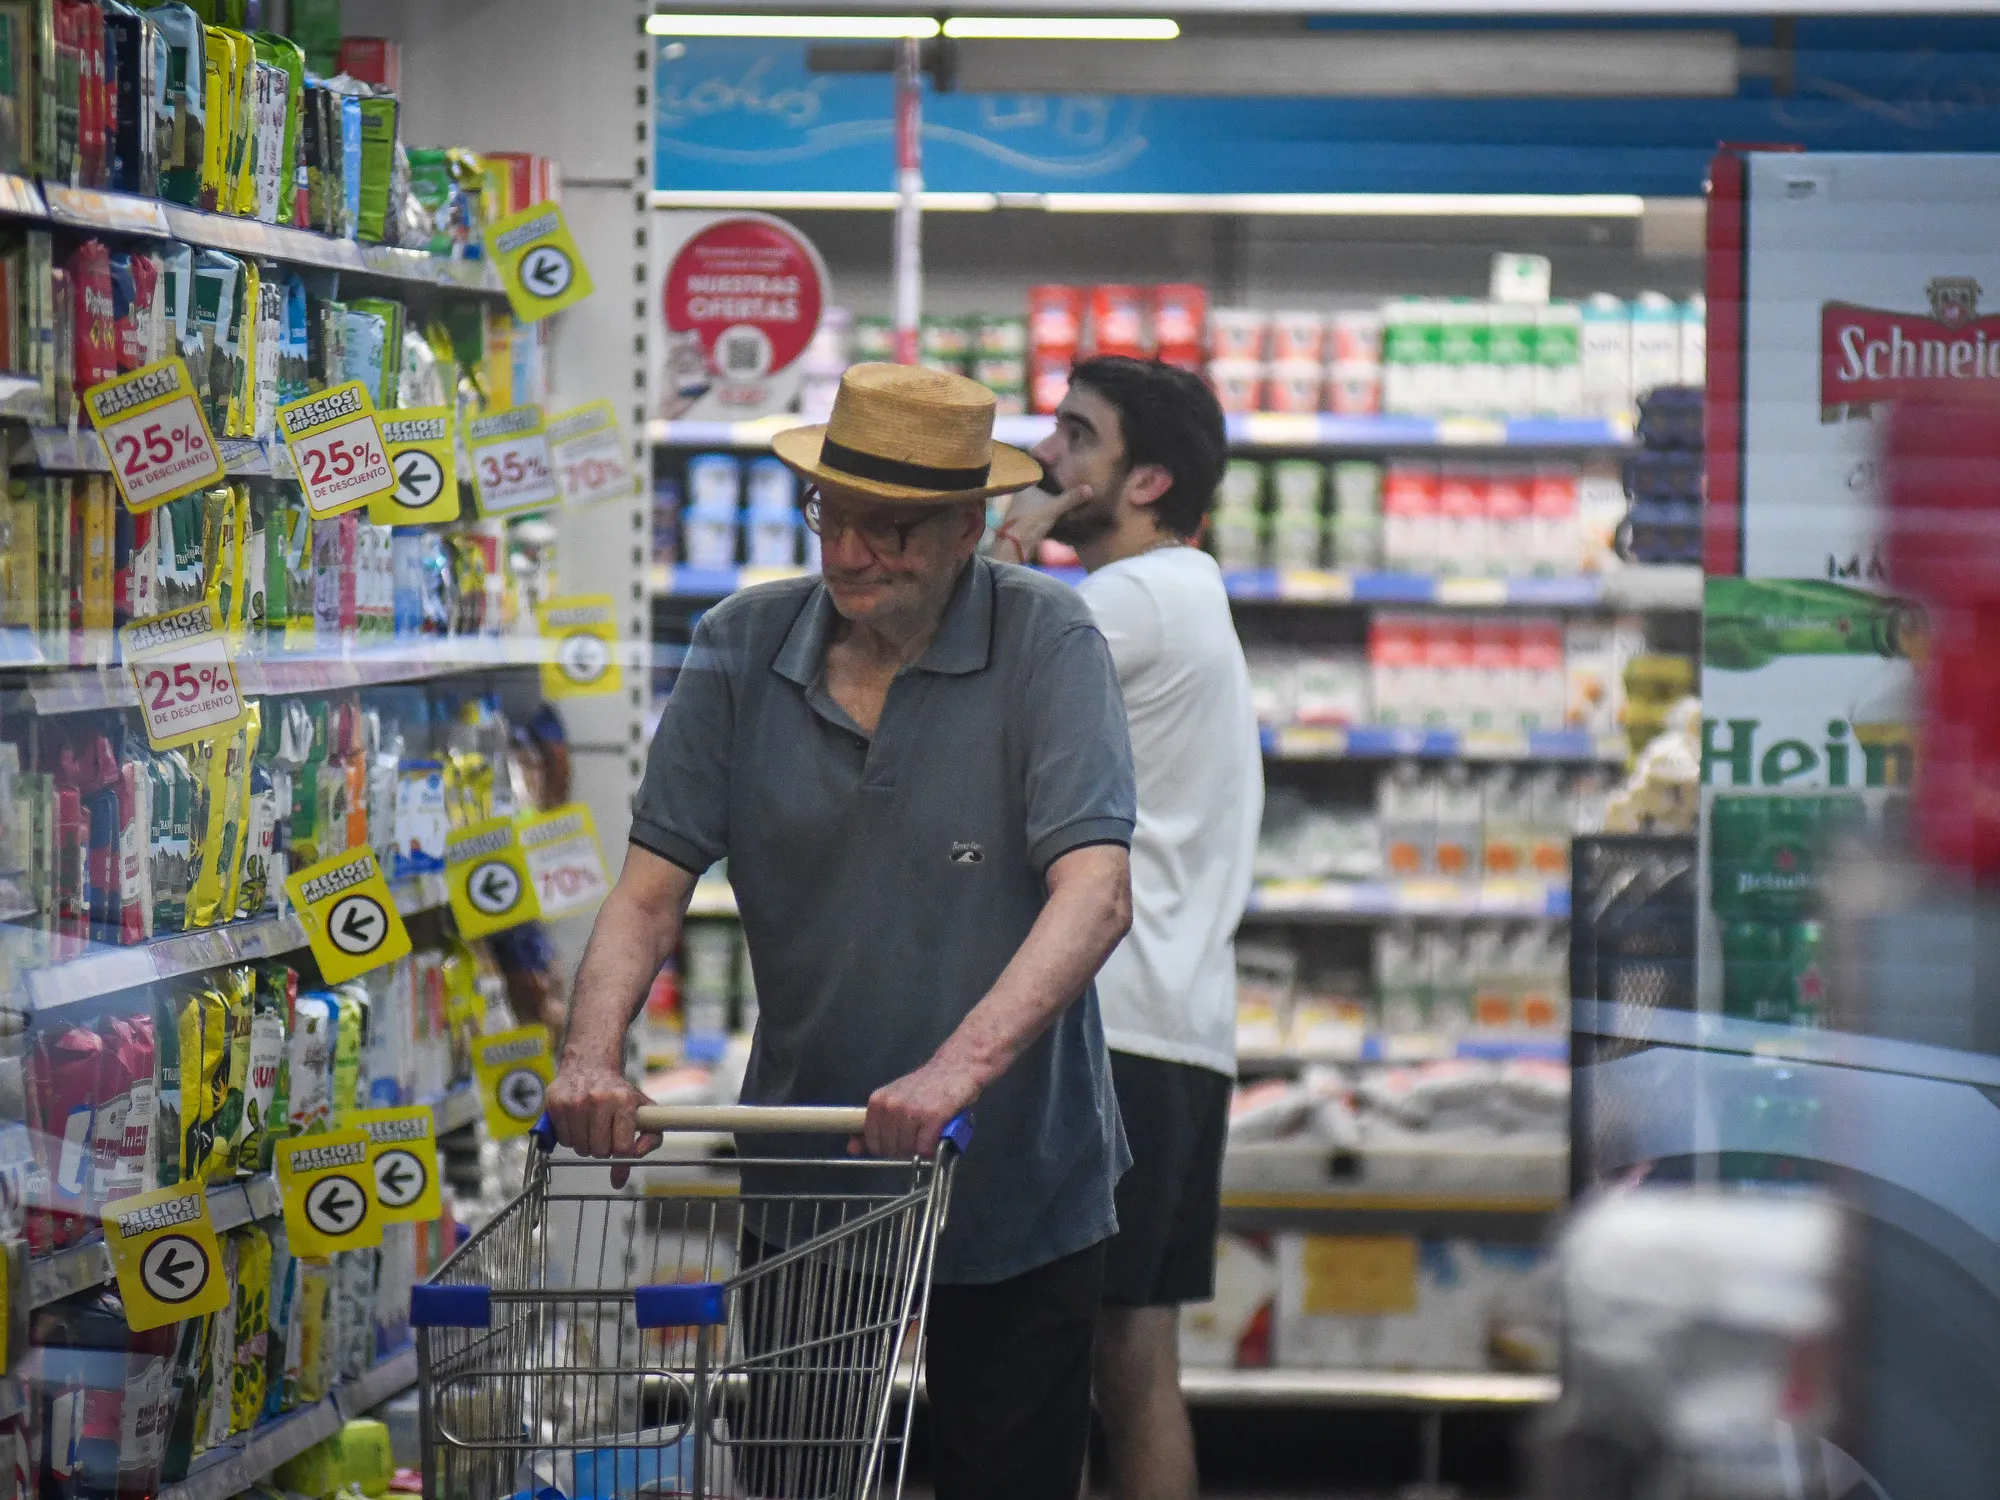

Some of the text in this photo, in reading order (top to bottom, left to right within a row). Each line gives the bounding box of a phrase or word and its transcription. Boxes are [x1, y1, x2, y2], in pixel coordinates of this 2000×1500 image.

[687, 274, 800, 294] NUESTRAS
[687, 297, 800, 322] OFERTAS
[115, 423, 203, 477] 25%
[303, 440, 381, 486] 25%
[128, 452, 209, 490] DE DESCUENTO
[314, 466, 386, 498] DE DESCUENTO
[481, 452, 551, 487] 35%
[144, 663, 229, 711] 25%
[154, 695, 232, 725] DE DESCUENTO
